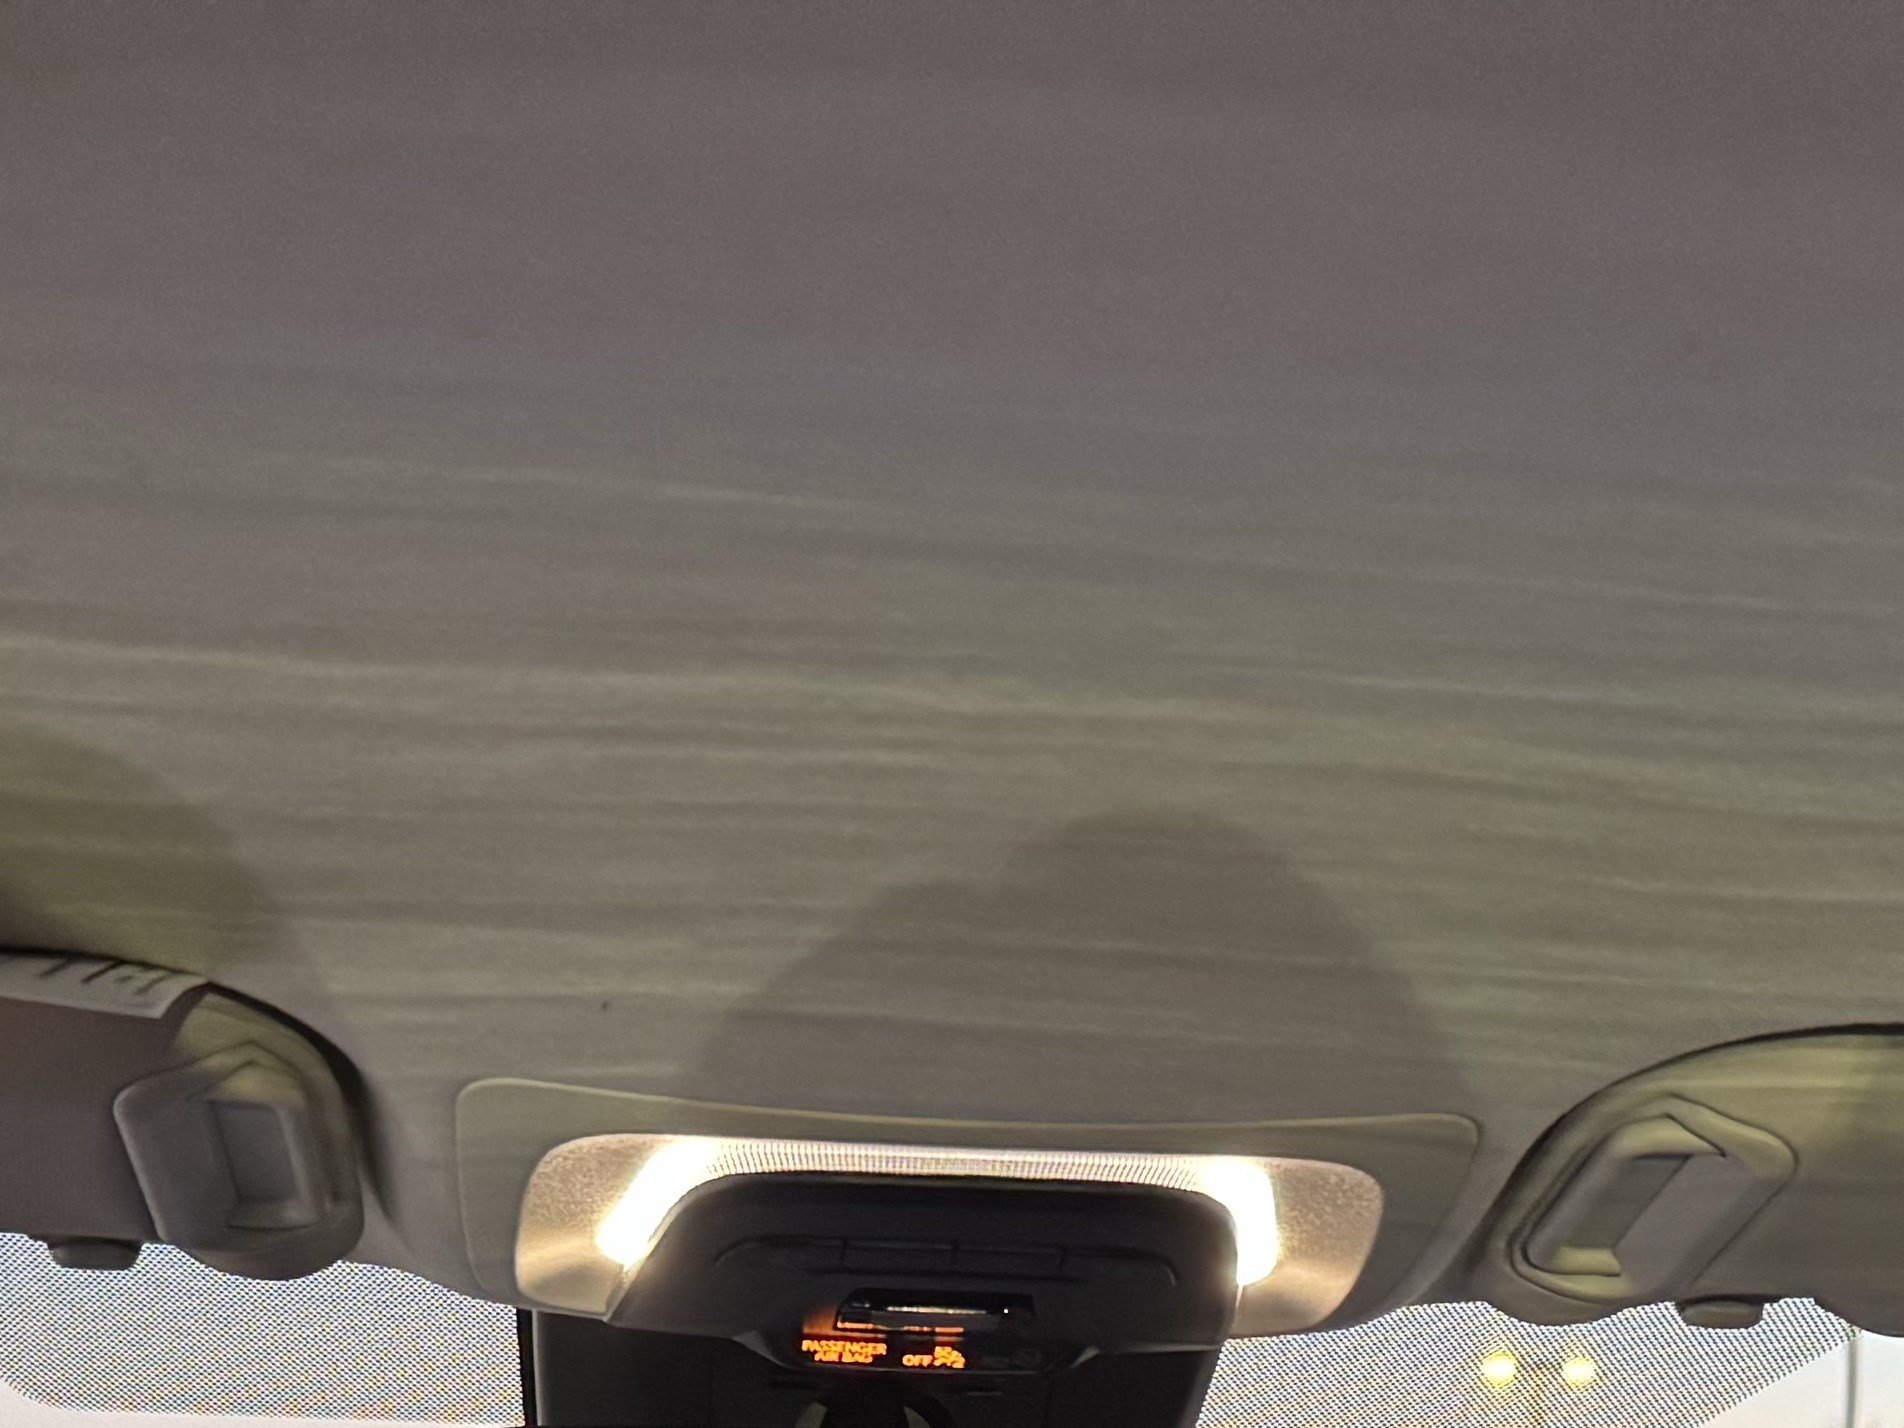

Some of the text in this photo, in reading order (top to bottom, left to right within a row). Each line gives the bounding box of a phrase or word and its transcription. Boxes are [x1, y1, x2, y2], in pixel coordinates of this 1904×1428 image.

[802, 1340, 887, 1355] PASSENGER
[814, 1351, 873, 1363] AIR BAG
[902, 1354, 933, 1367] OFF
